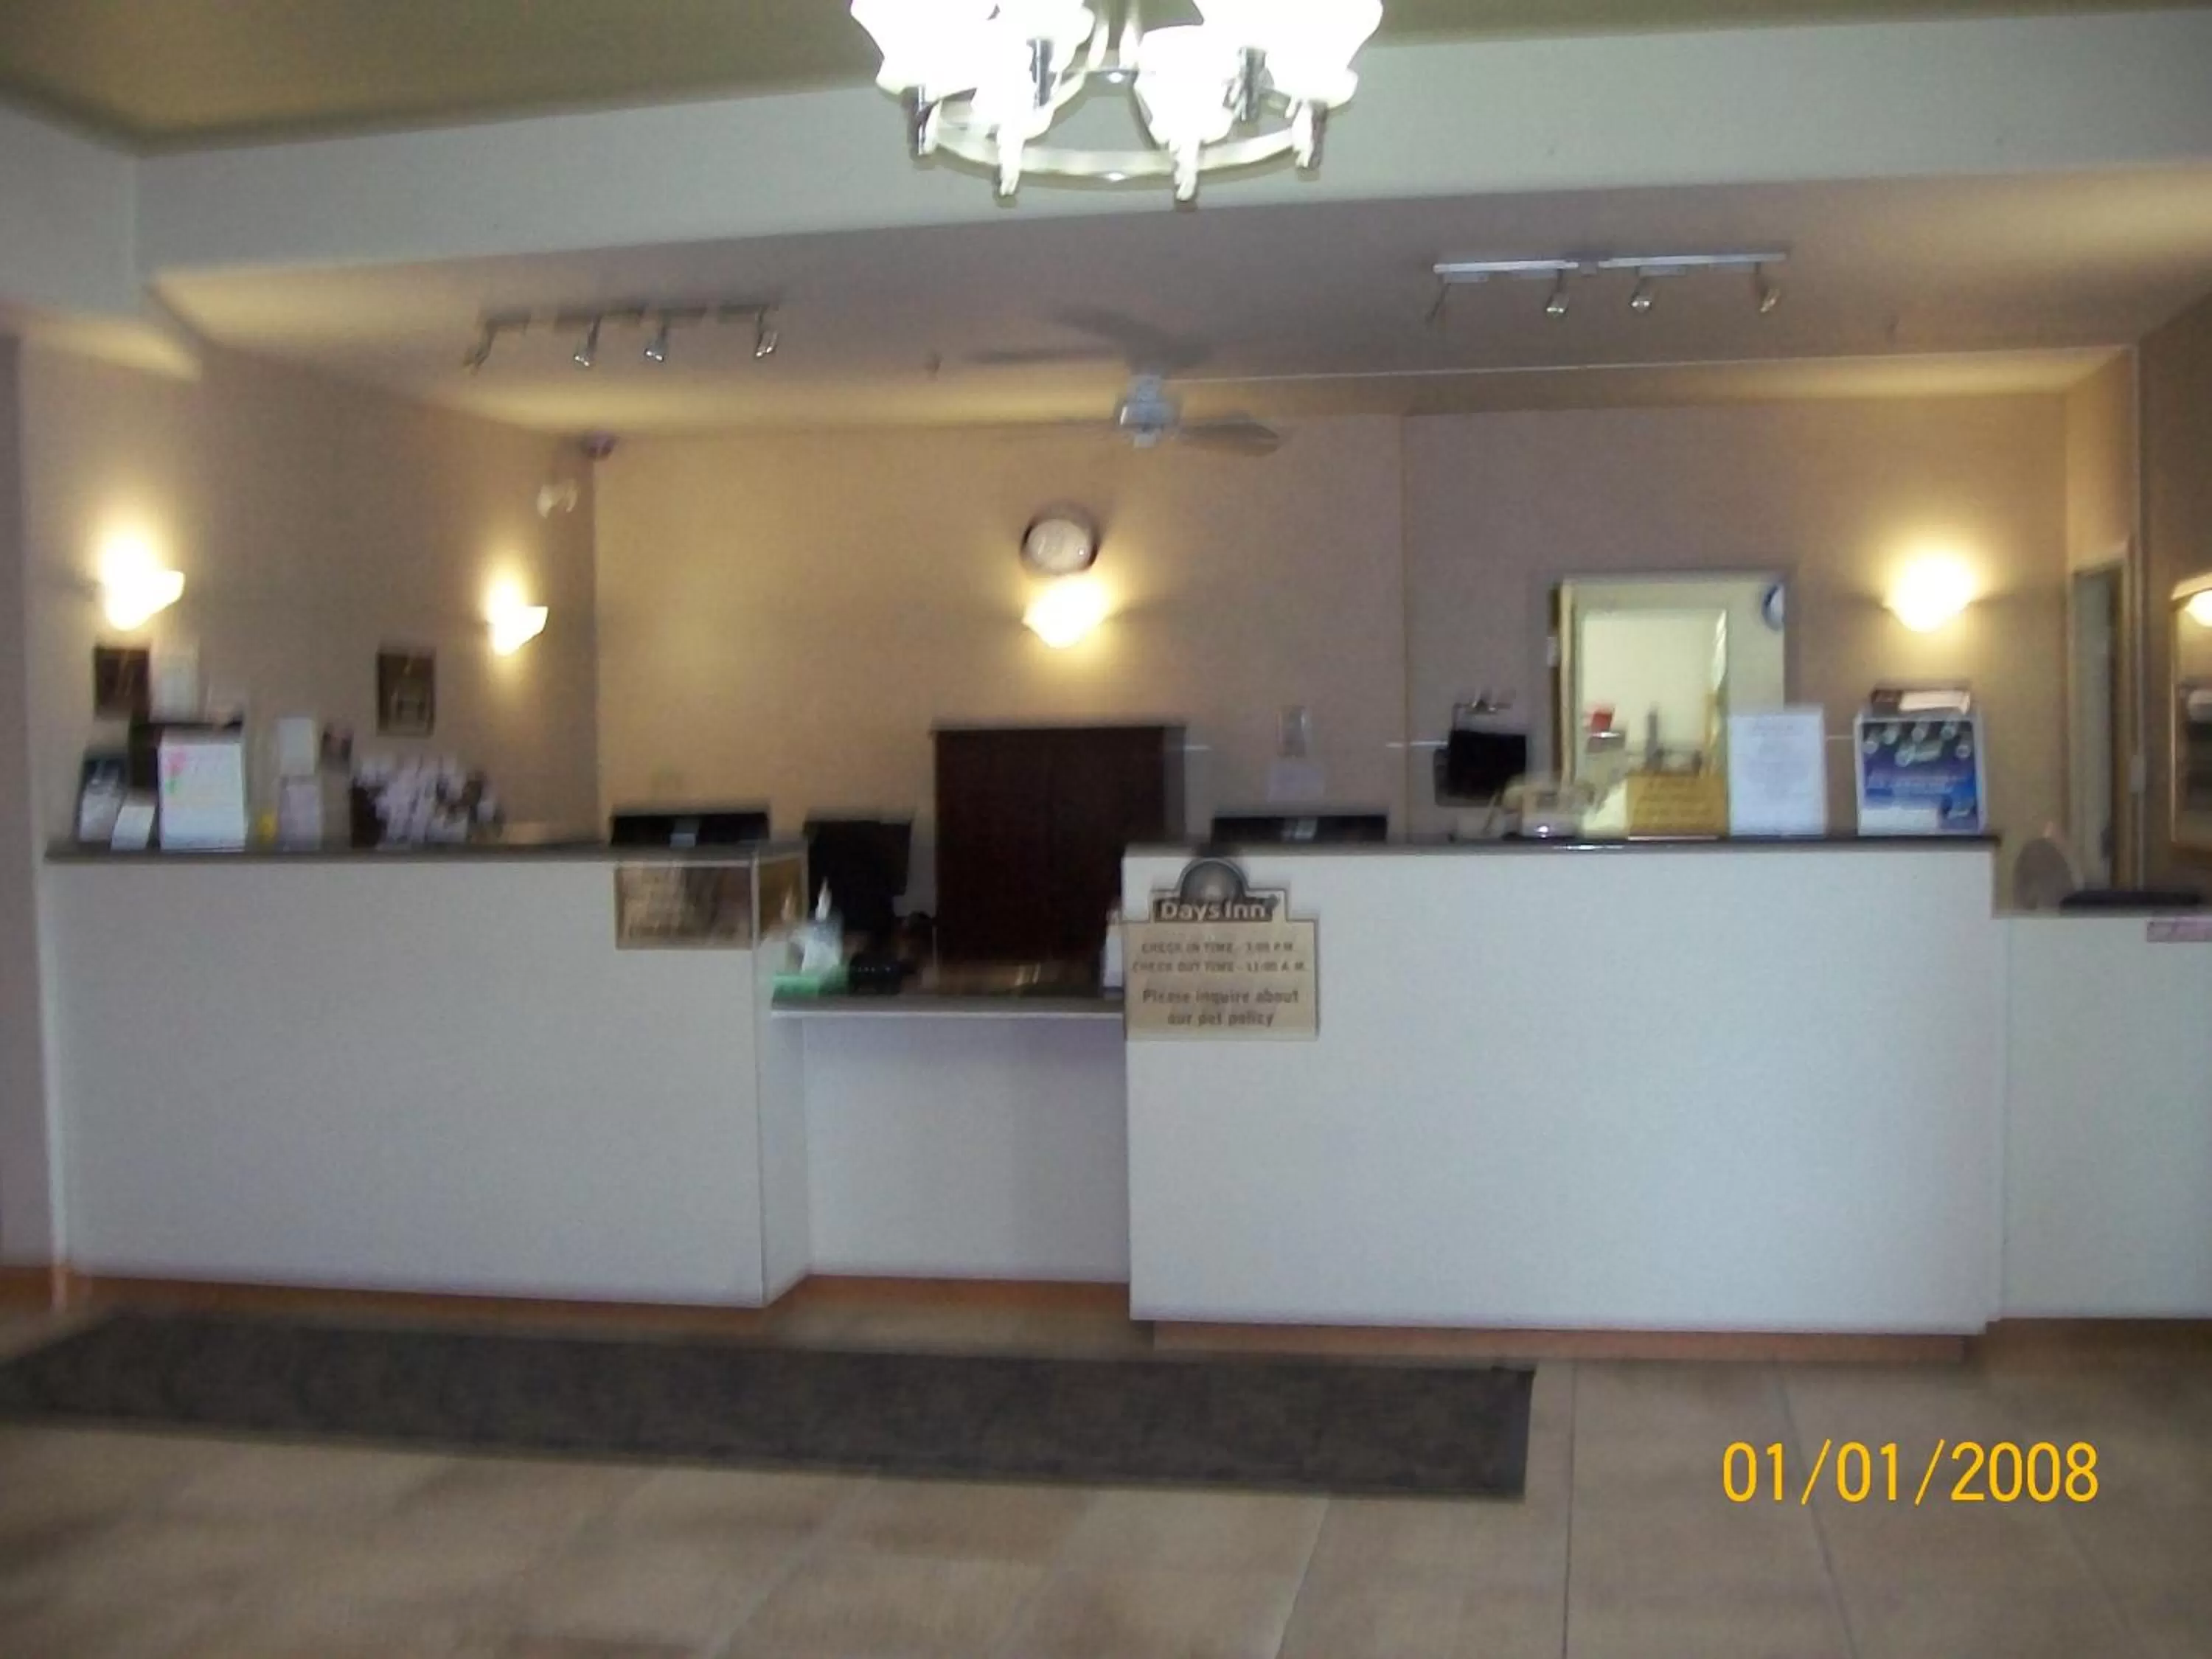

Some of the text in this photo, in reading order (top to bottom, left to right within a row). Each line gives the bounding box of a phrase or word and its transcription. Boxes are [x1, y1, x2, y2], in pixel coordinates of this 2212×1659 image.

[1160, 900, 1265, 921] Days Inn
[1142, 987, 1298, 1005] Please inquire about
[1167, 1011, 1274, 1028] our pet policy
